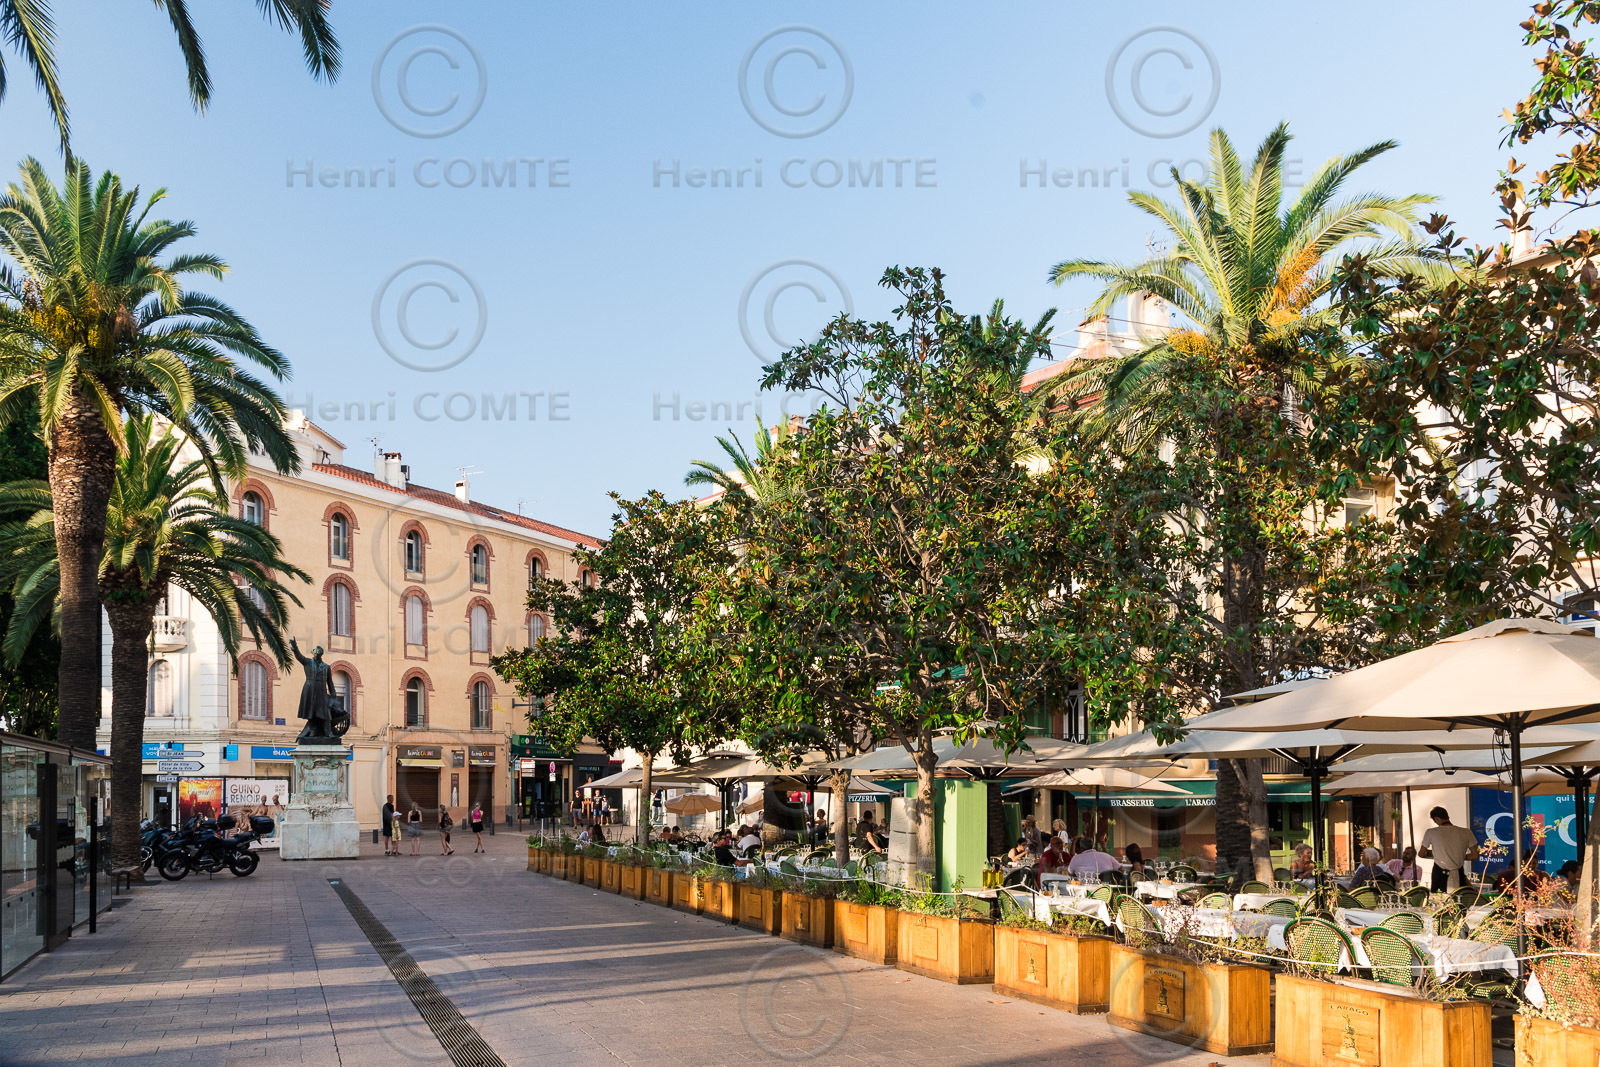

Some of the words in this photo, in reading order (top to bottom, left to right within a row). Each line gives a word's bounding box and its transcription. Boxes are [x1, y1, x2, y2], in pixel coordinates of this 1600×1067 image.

[230, 784, 260, 794] GUINO
[230, 795, 261, 804] RENOIR
[1110, 799, 1155, 807] BRASSERIE
[1555, 794, 1570, 803] qui
[1479, 855, 1504, 863] Banque
